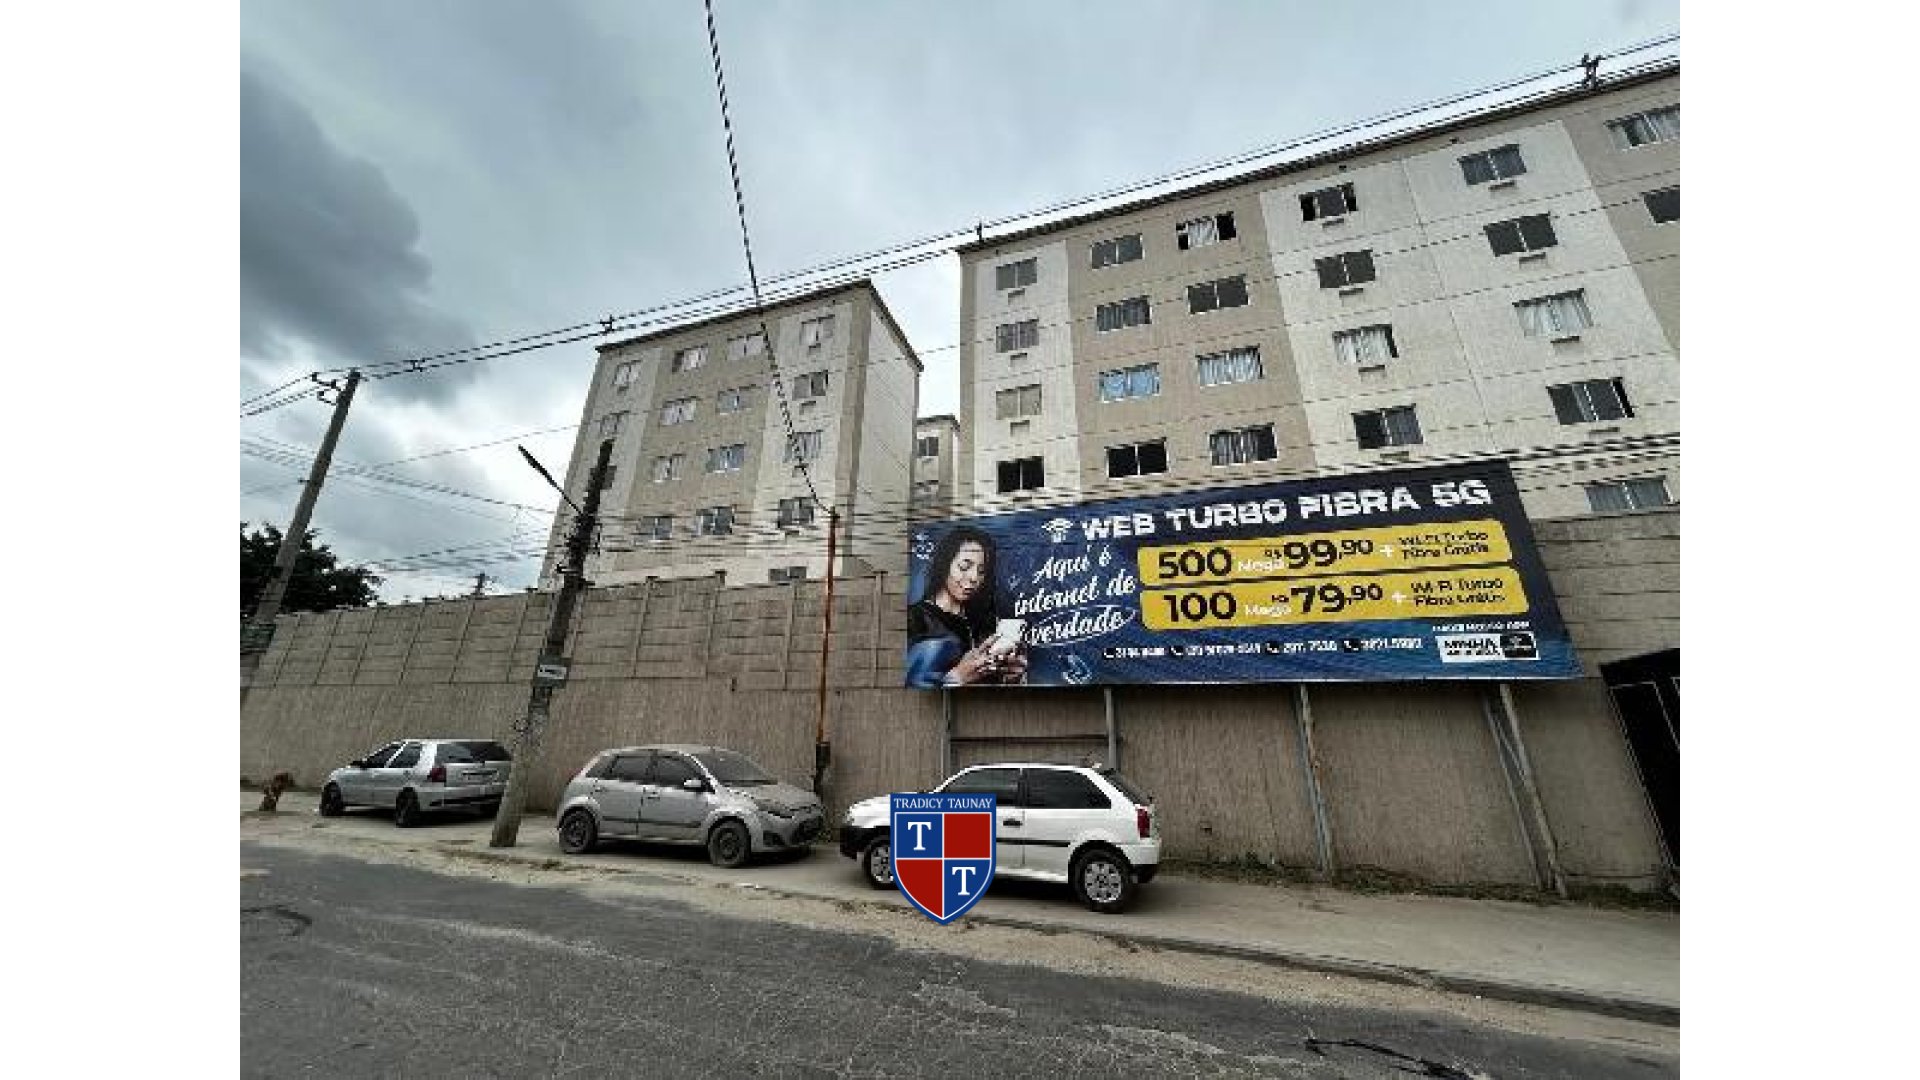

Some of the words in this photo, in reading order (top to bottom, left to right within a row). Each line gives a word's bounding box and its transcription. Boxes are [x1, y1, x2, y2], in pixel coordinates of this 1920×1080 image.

[1082, 512, 1155, 541] WEB
[1164, 499, 1287, 531] TURBO
[1298, 486, 1421, 519] FIBRA
[1432, 479, 1492, 507] 5G
[1158, 547, 1232, 579] 500
[1014, 575, 1099, 617] internet
[1106, 568, 1136, 596] de
[1162, 591, 1237, 622] 100
[1031, 606, 1121, 644] verdade
